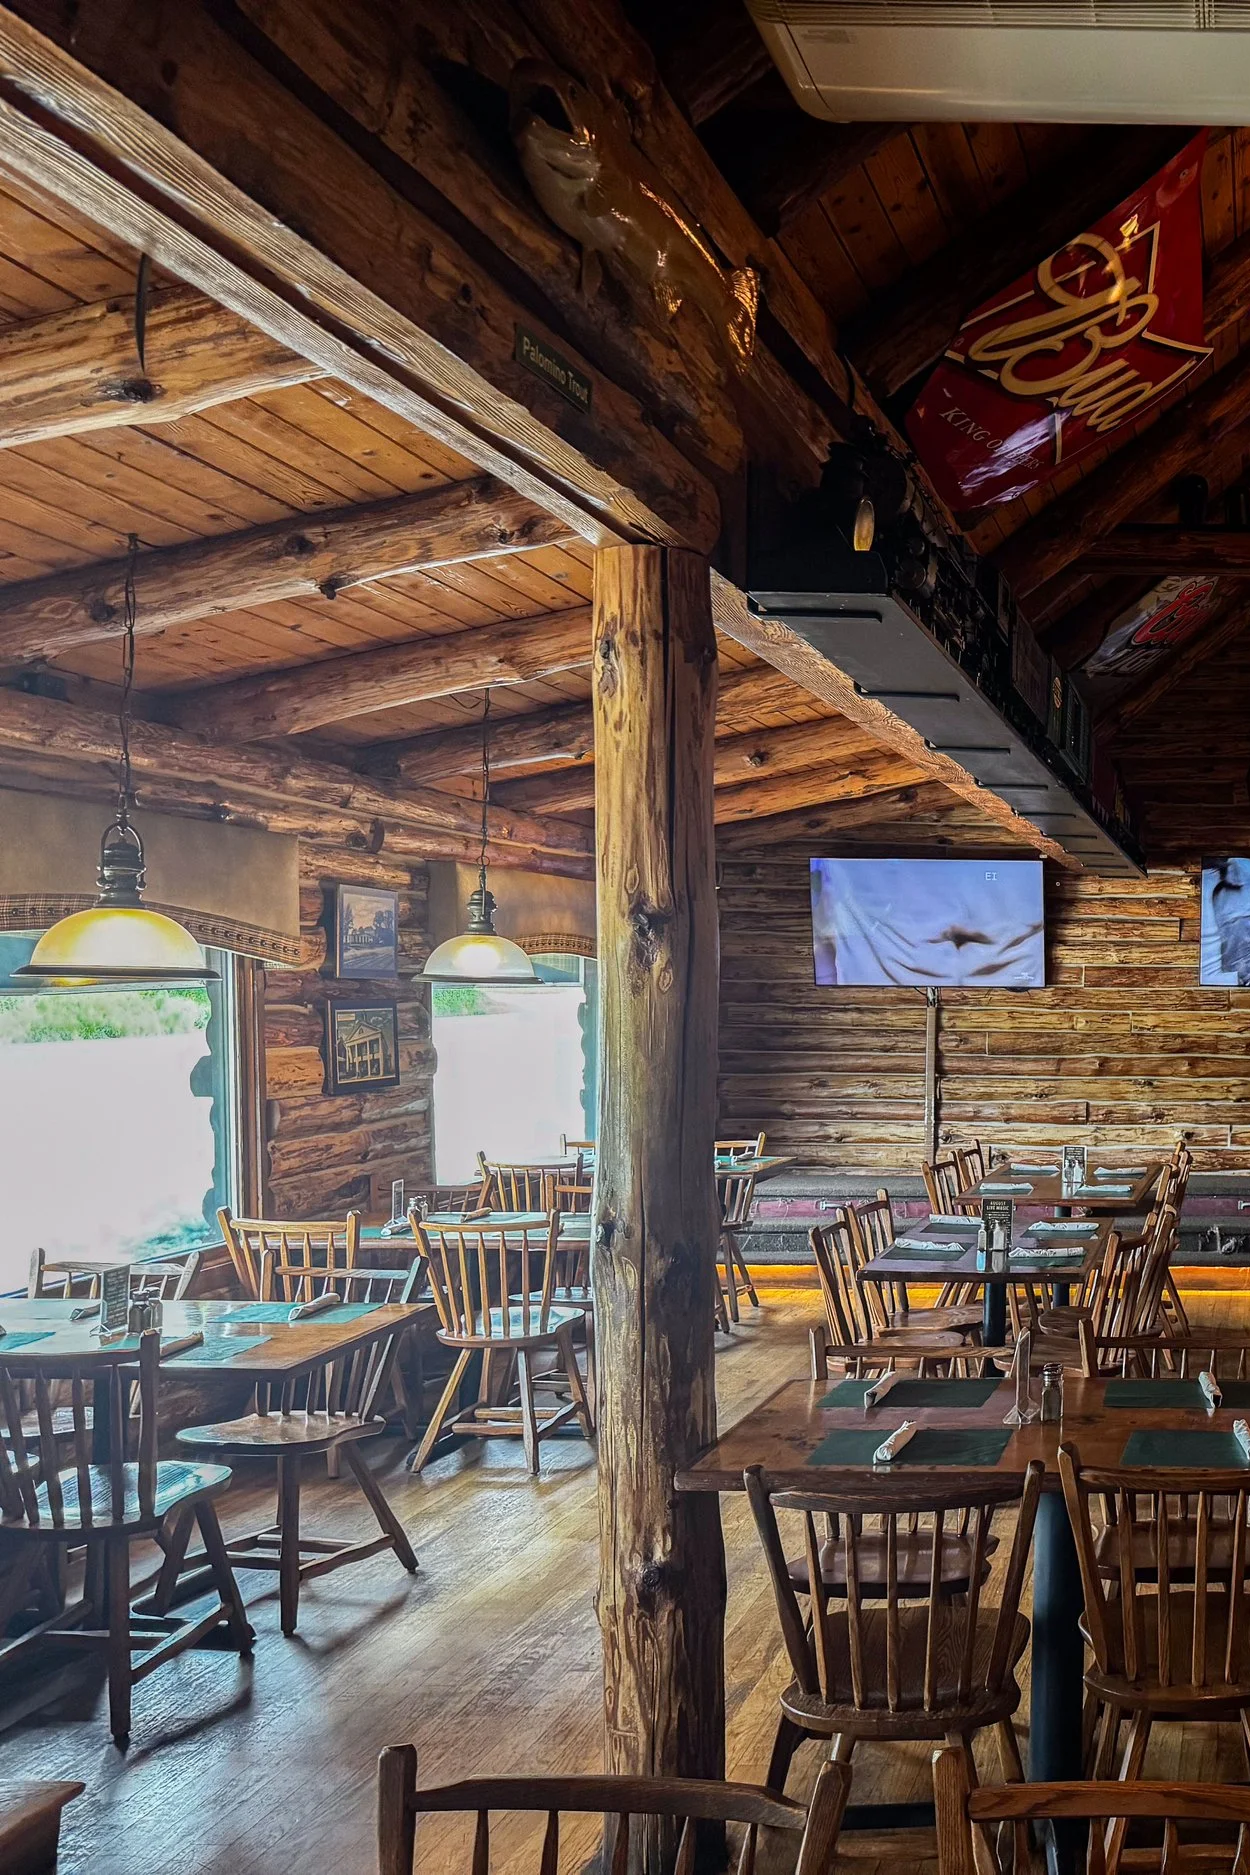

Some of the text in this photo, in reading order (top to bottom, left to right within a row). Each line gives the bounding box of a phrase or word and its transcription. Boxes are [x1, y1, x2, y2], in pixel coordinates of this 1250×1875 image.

[522, 335, 588, 404] Palomino Trout
[939, 406, 991, 442] KING
